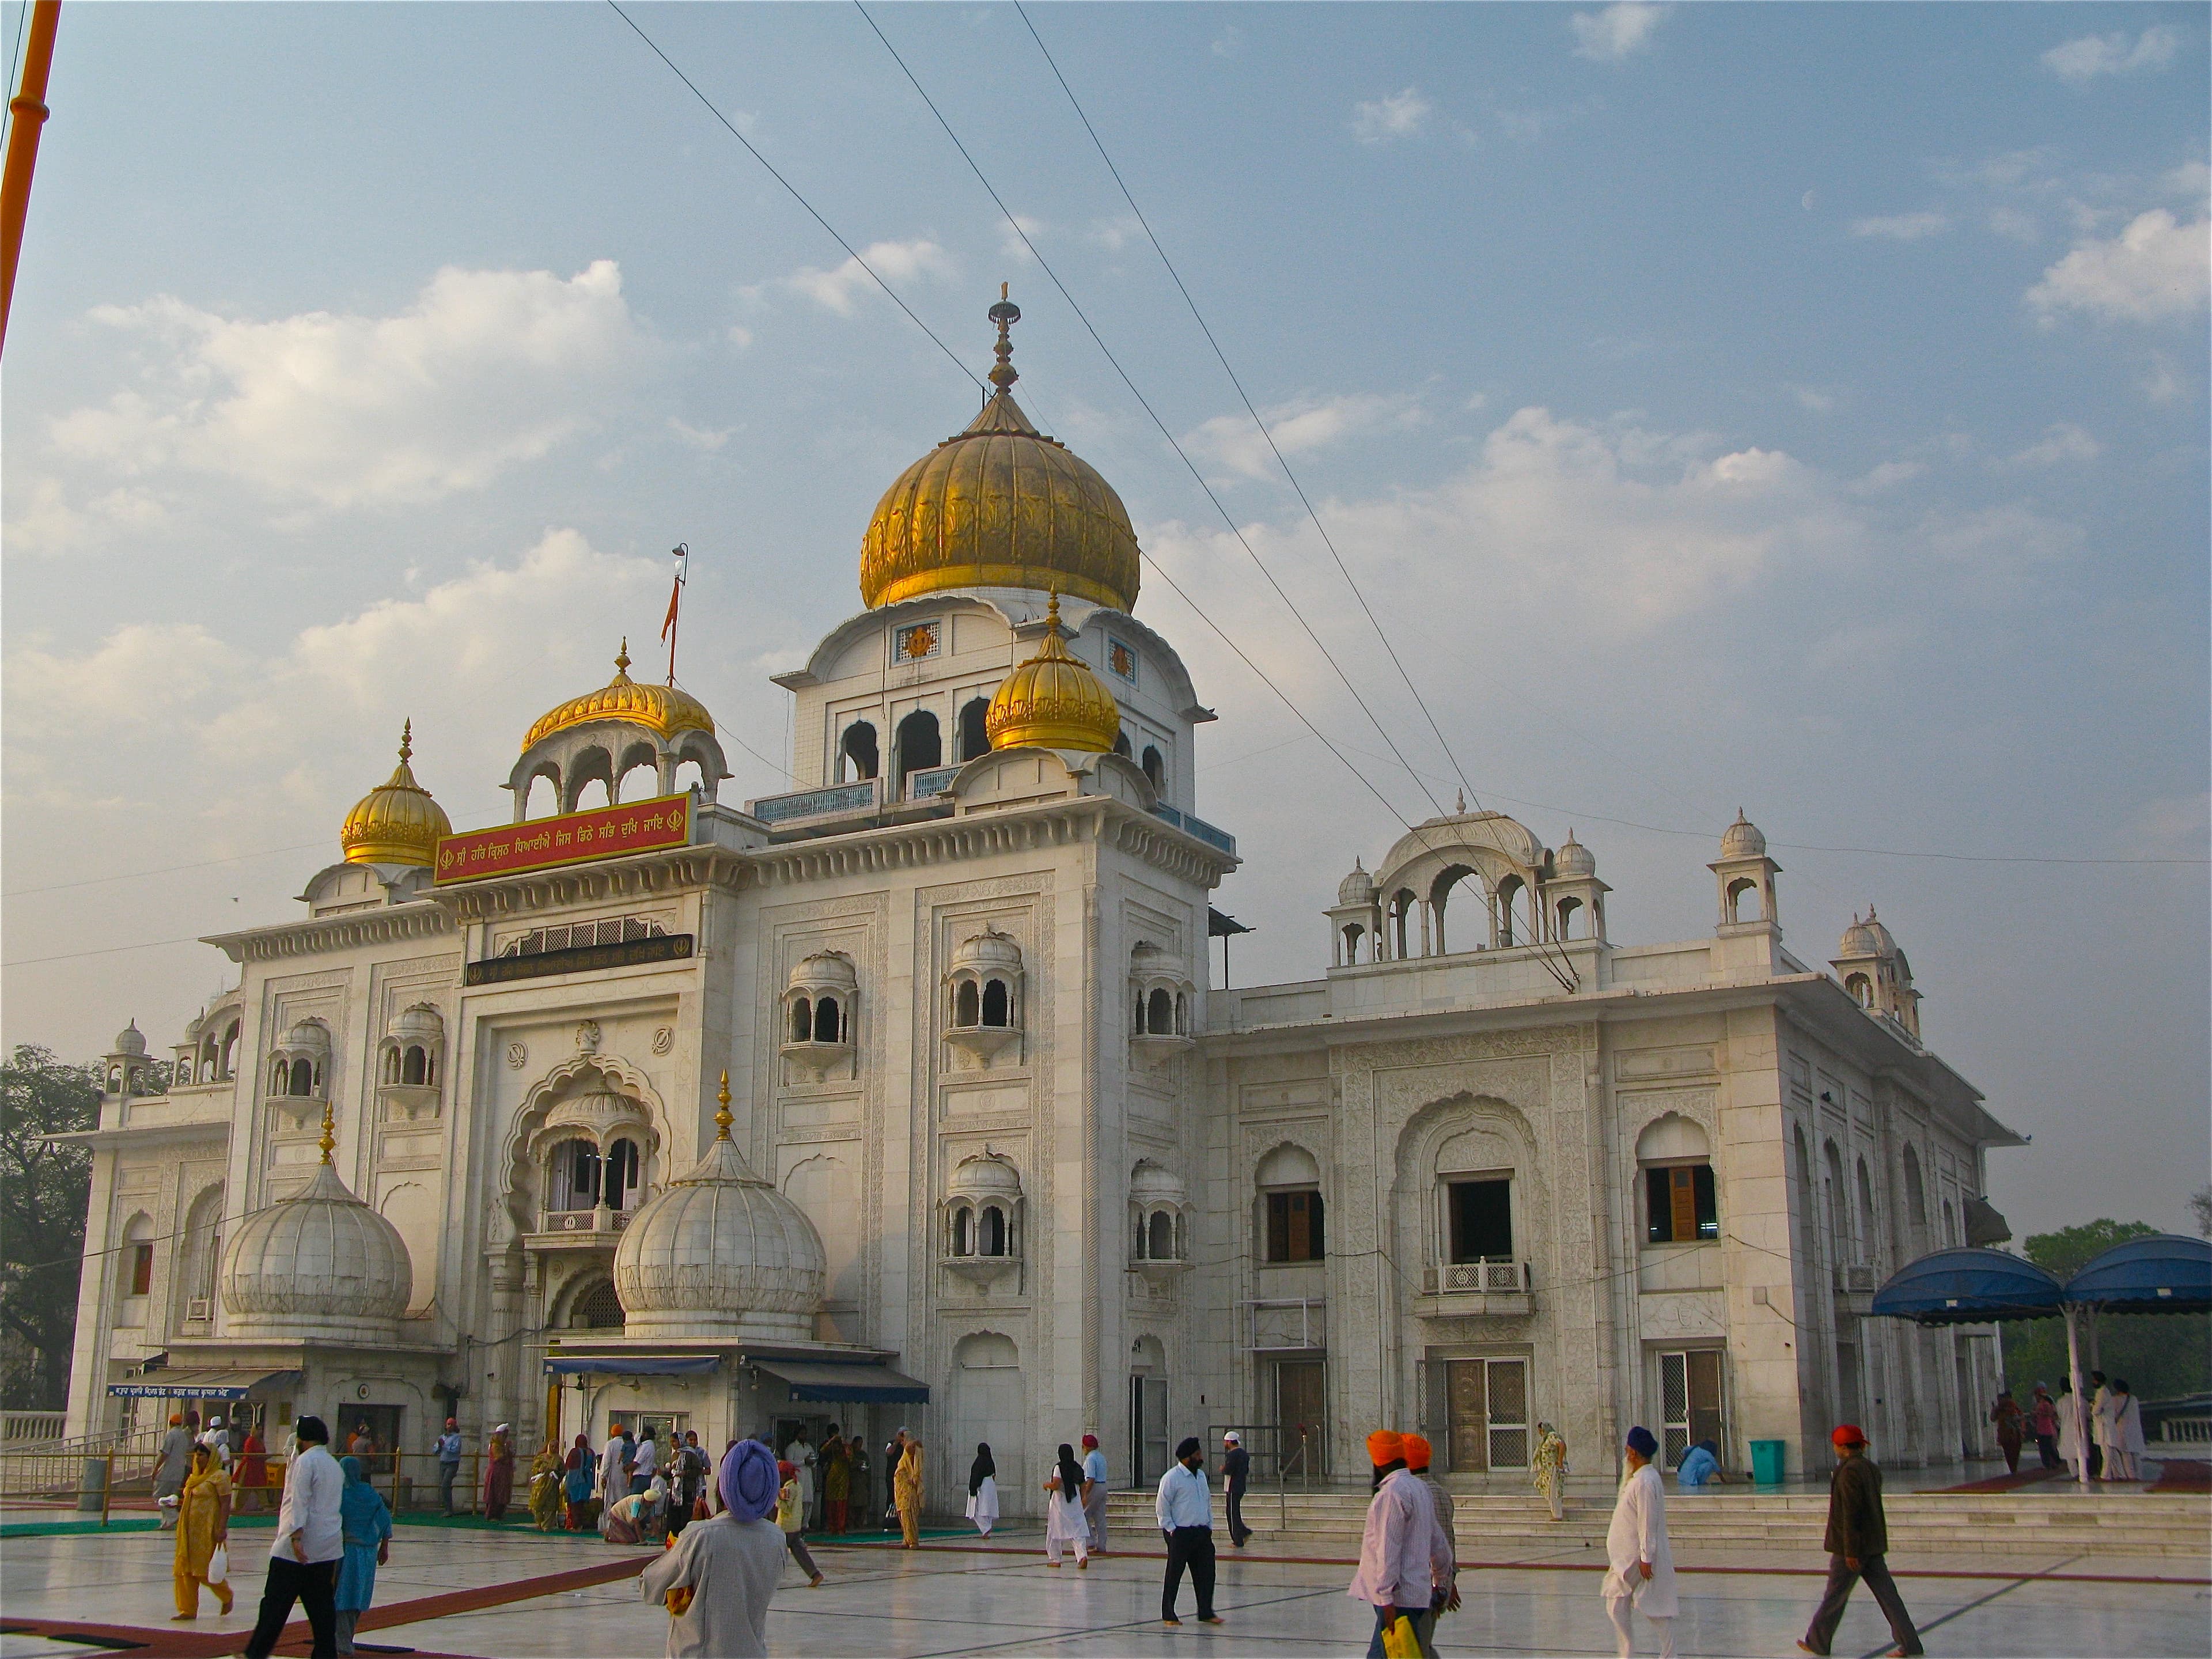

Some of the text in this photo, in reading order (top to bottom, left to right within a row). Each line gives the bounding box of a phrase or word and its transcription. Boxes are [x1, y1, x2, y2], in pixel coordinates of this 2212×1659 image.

[471, 844, 486, 861] ਹਰਿ
[556, 830, 571, 846] ਜਿਸ
[599, 821, 616, 839] ਸਭਿ
[643, 813, 664, 832] ਜਾਇ
